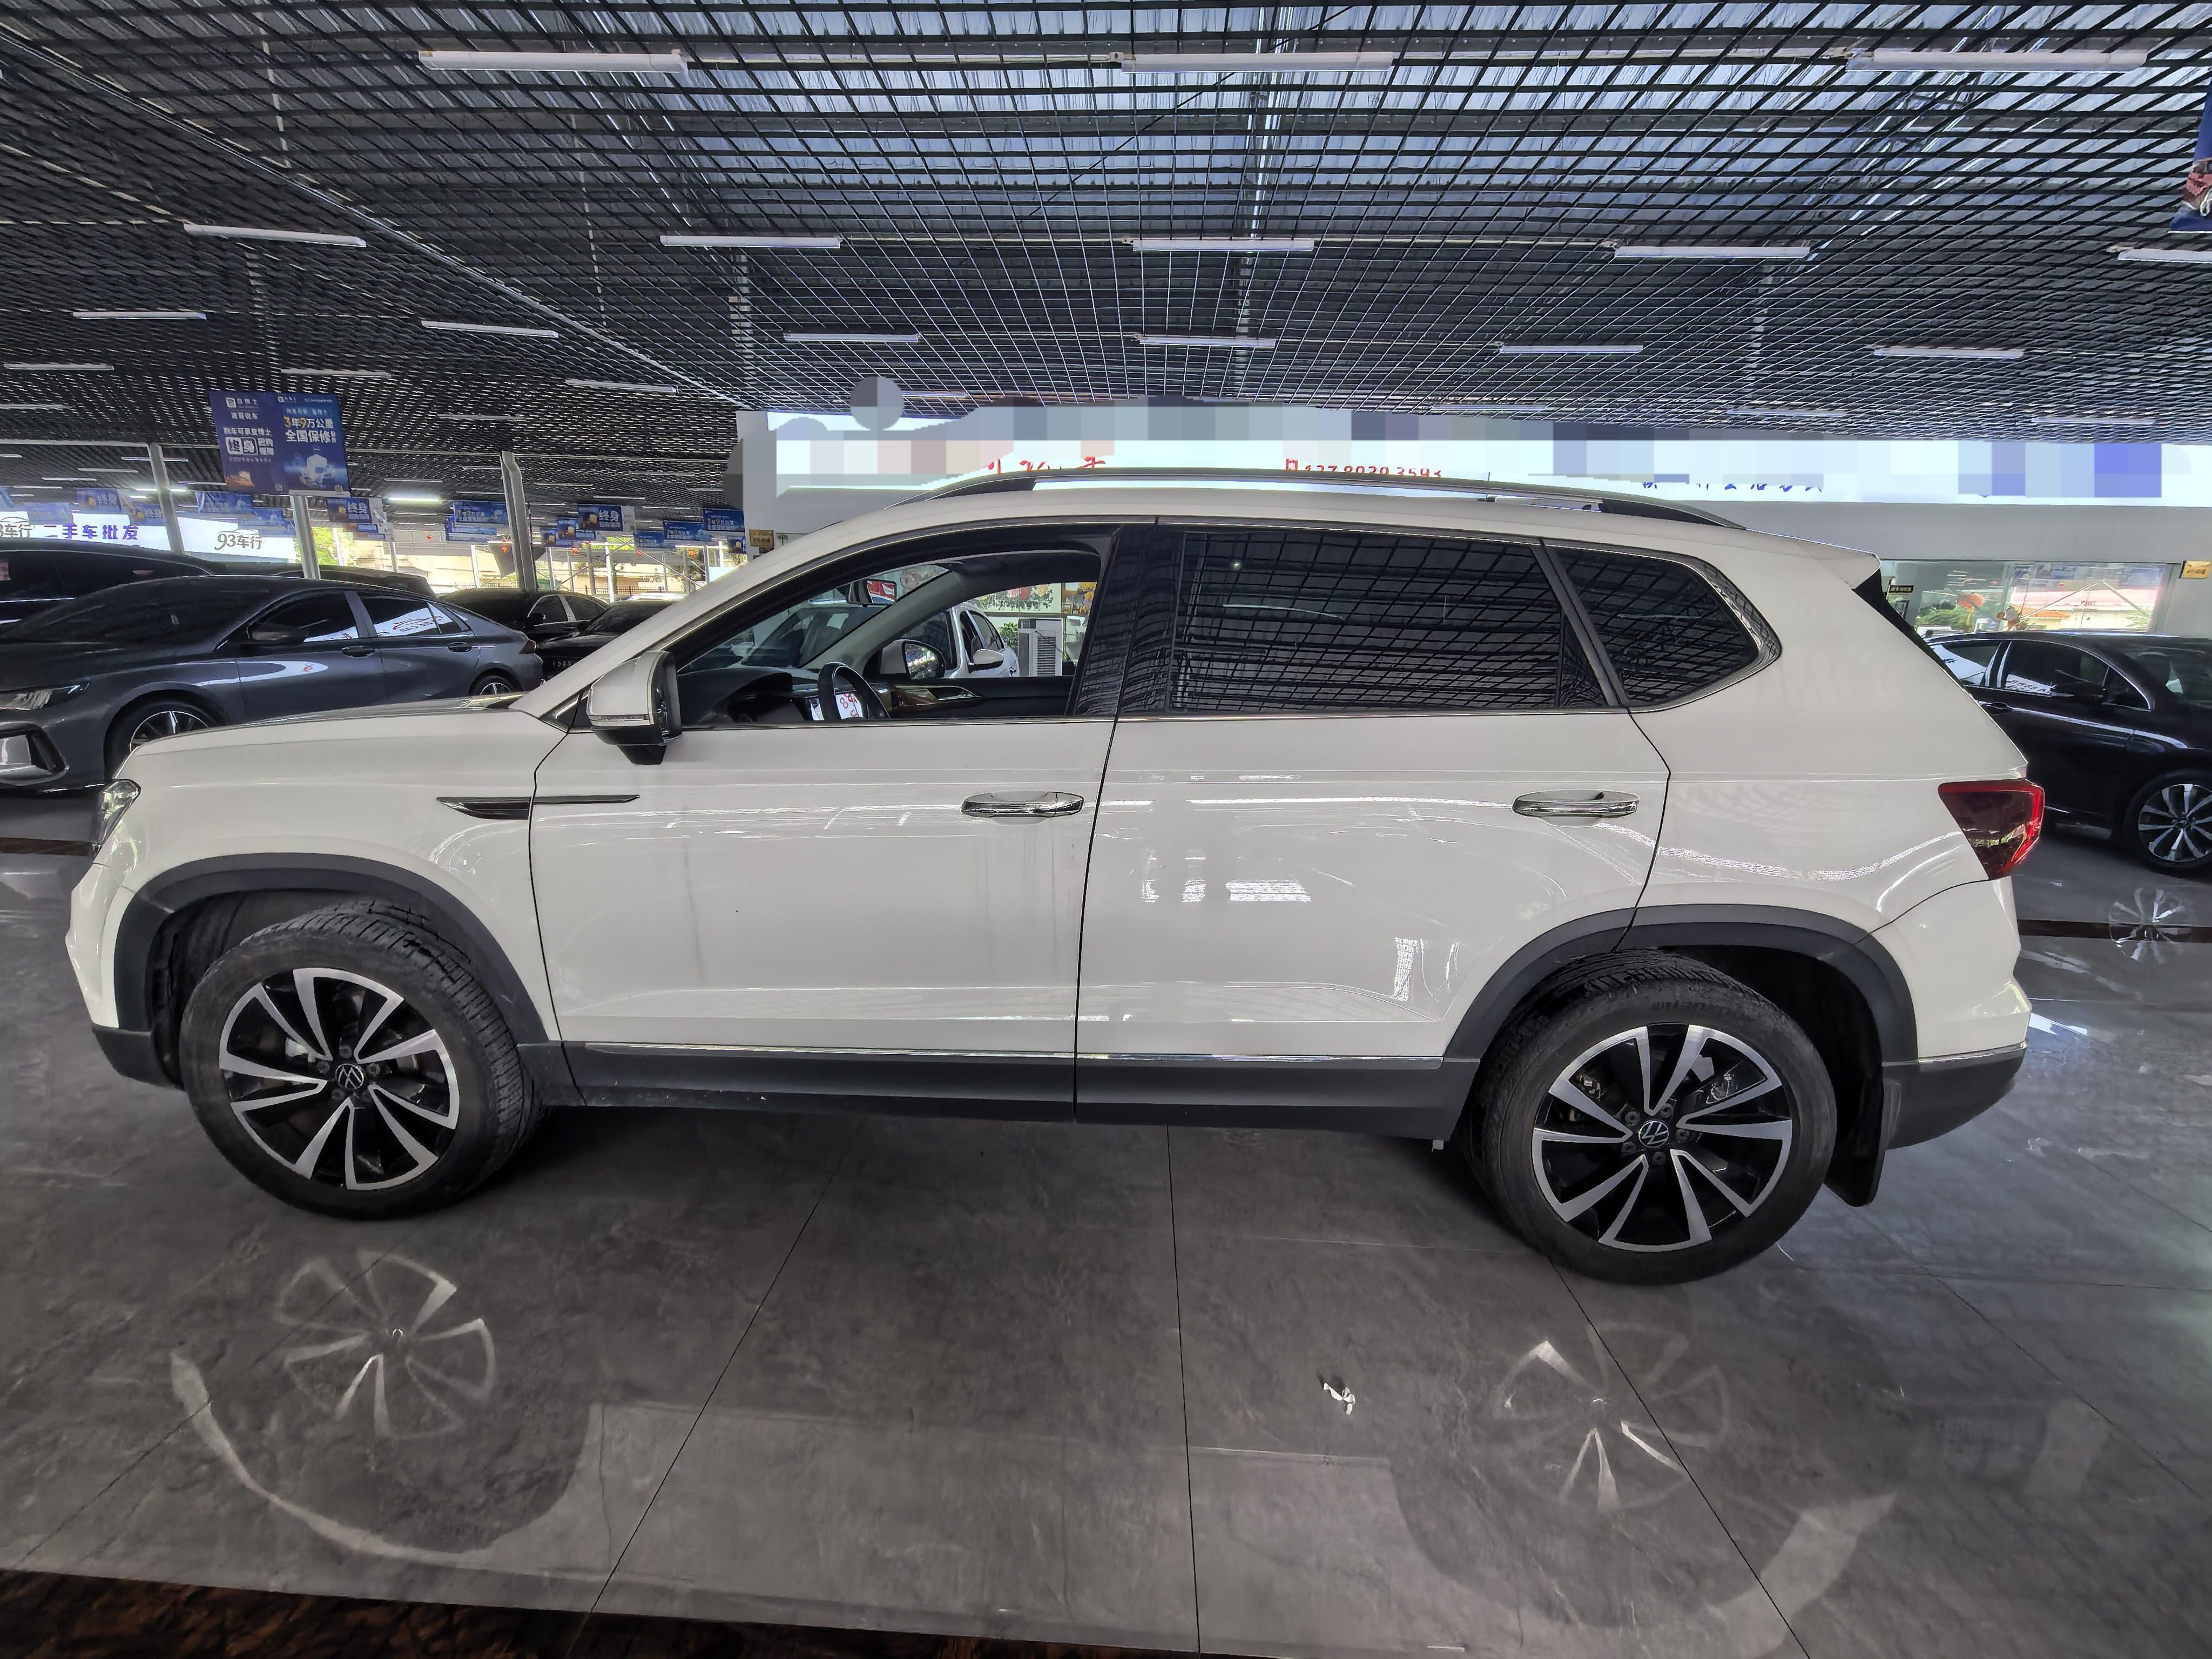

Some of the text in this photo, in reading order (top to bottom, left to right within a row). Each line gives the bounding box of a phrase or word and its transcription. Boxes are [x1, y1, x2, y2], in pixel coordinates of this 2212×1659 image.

[284, 415, 334, 429] 3年9万公里
[226, 437, 258, 455] 终身
[347, 502, 368, 514] 终身
[598, 510, 619, 522] 终身
[44, 524, 139, 539] 二手车批发
[214, 533, 263, 551] 93车行
